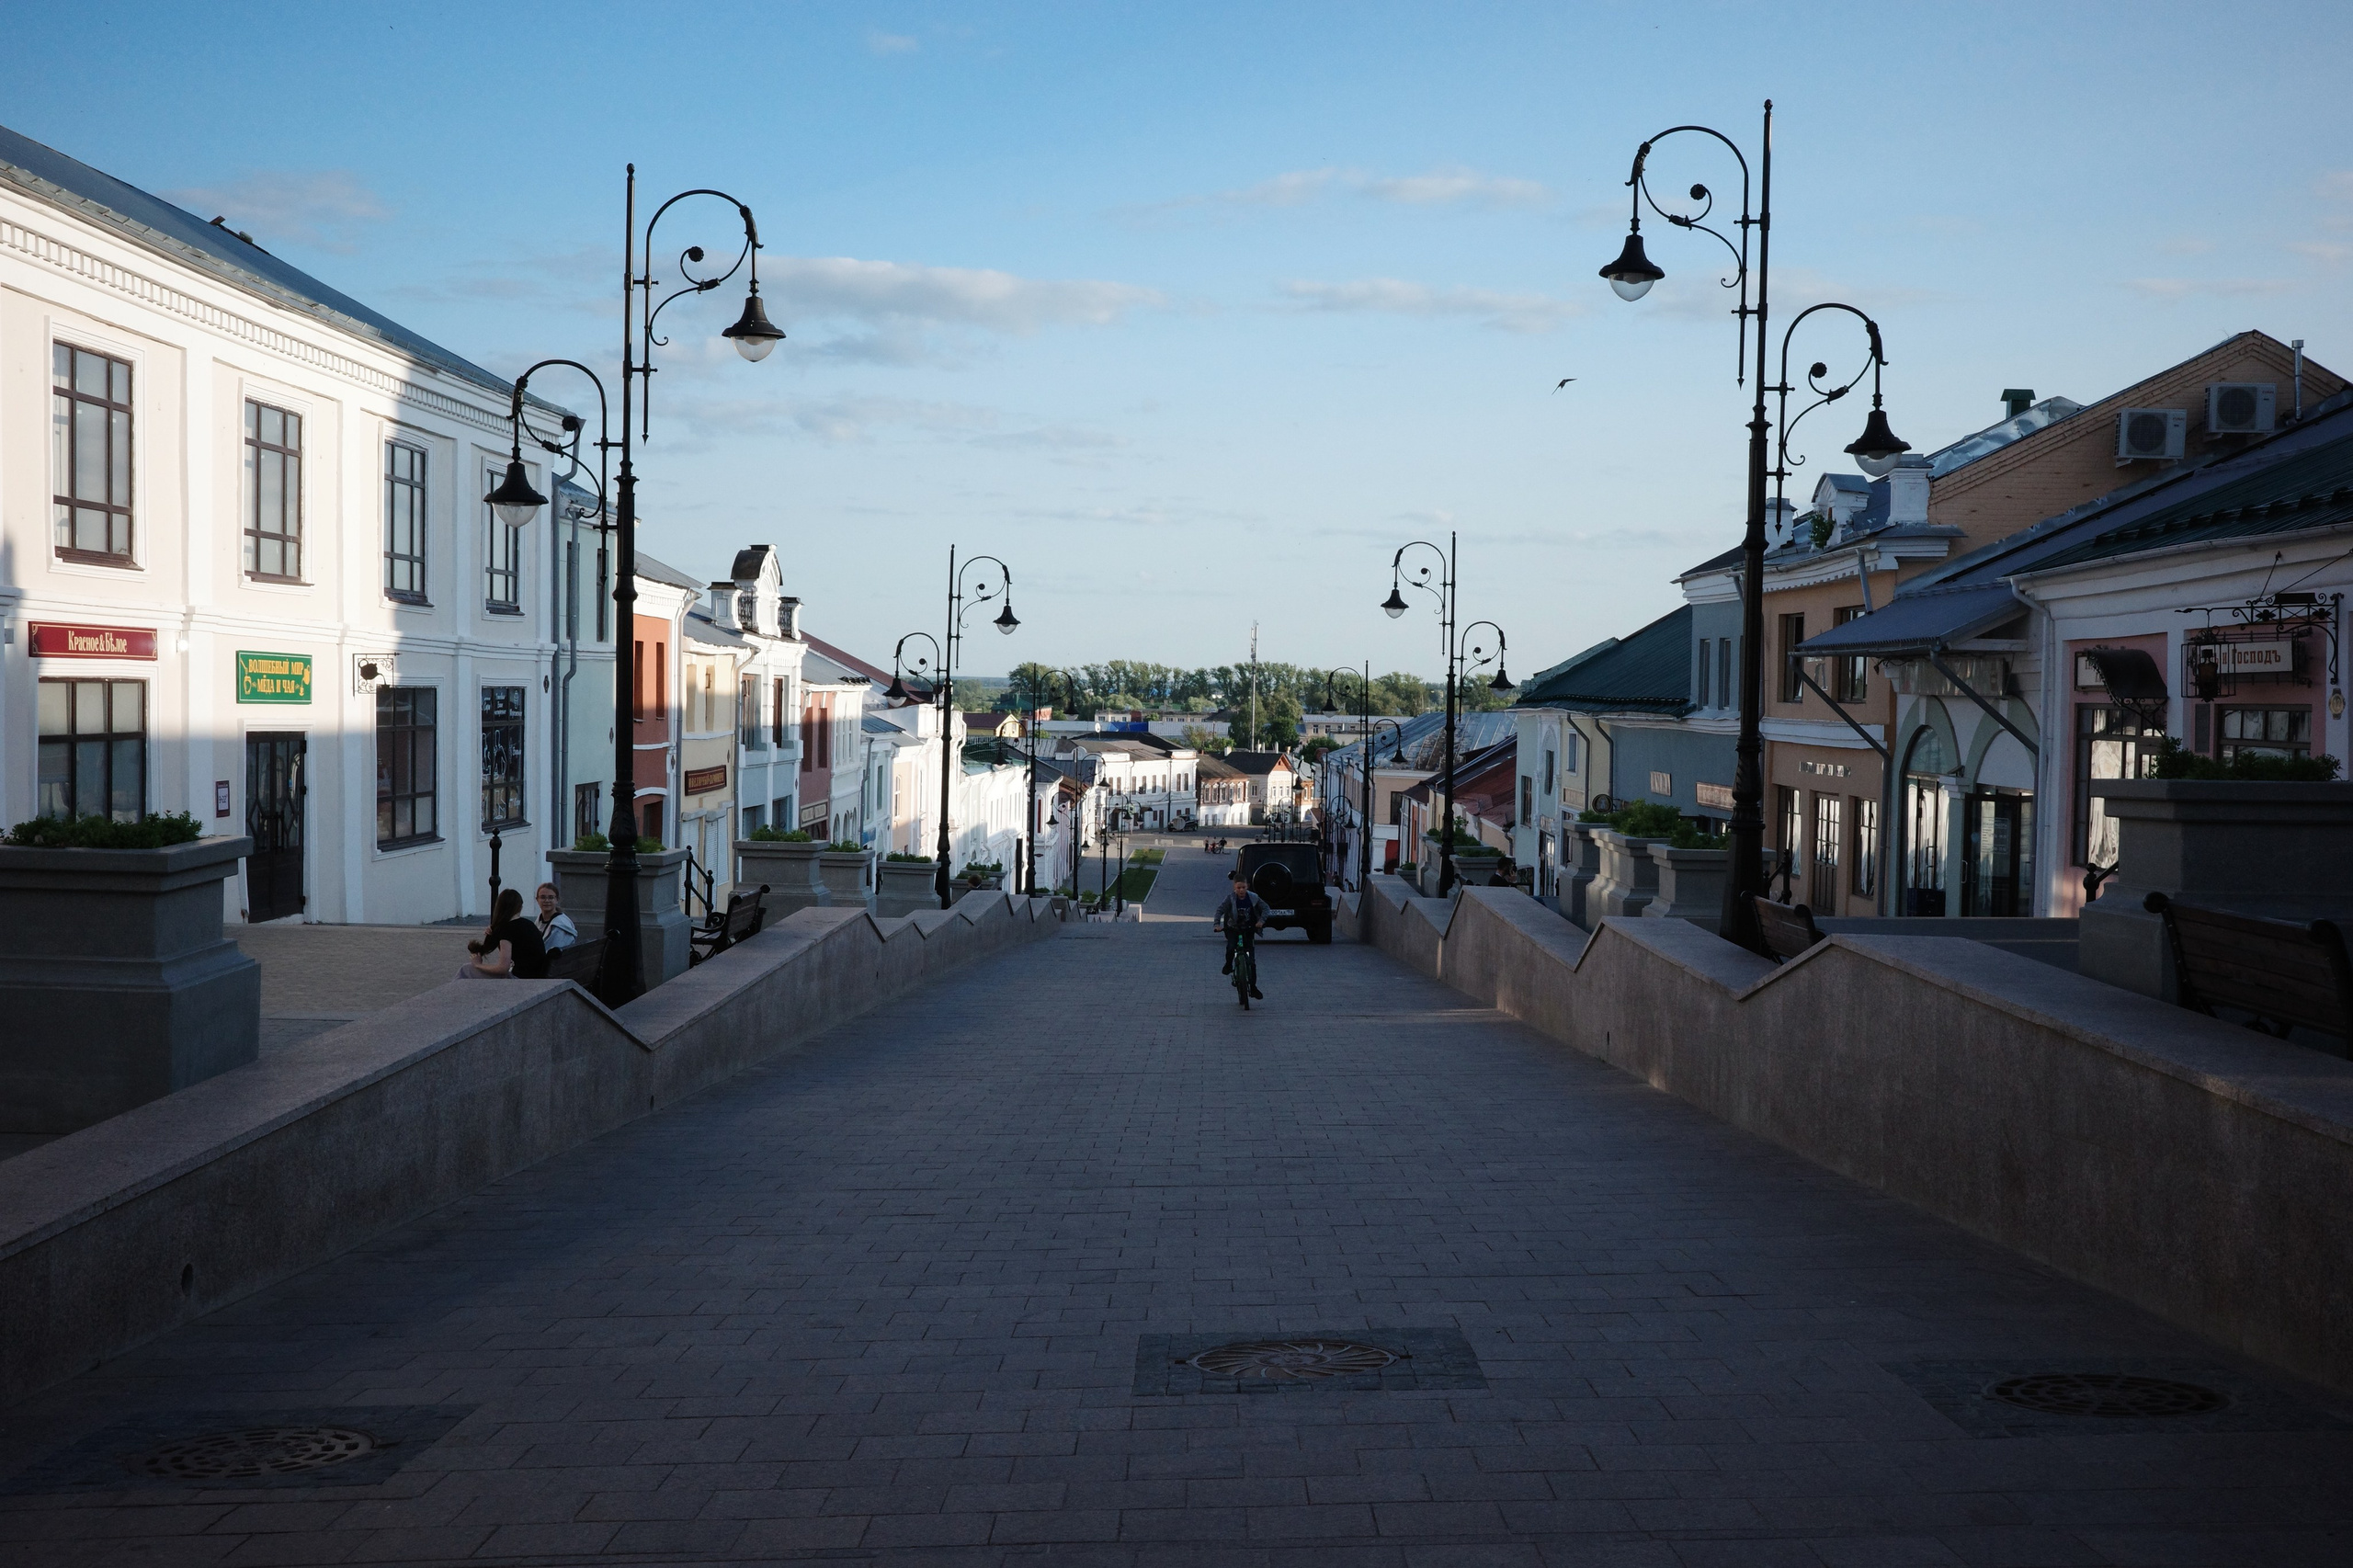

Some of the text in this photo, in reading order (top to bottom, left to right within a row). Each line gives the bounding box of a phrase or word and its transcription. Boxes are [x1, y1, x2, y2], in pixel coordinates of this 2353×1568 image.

[248, 658, 304, 675] ВОЛШЕБНЫЙ МИР
[276, 679, 281, 693] И
[282, 679, 295, 694] ЧАЯ
